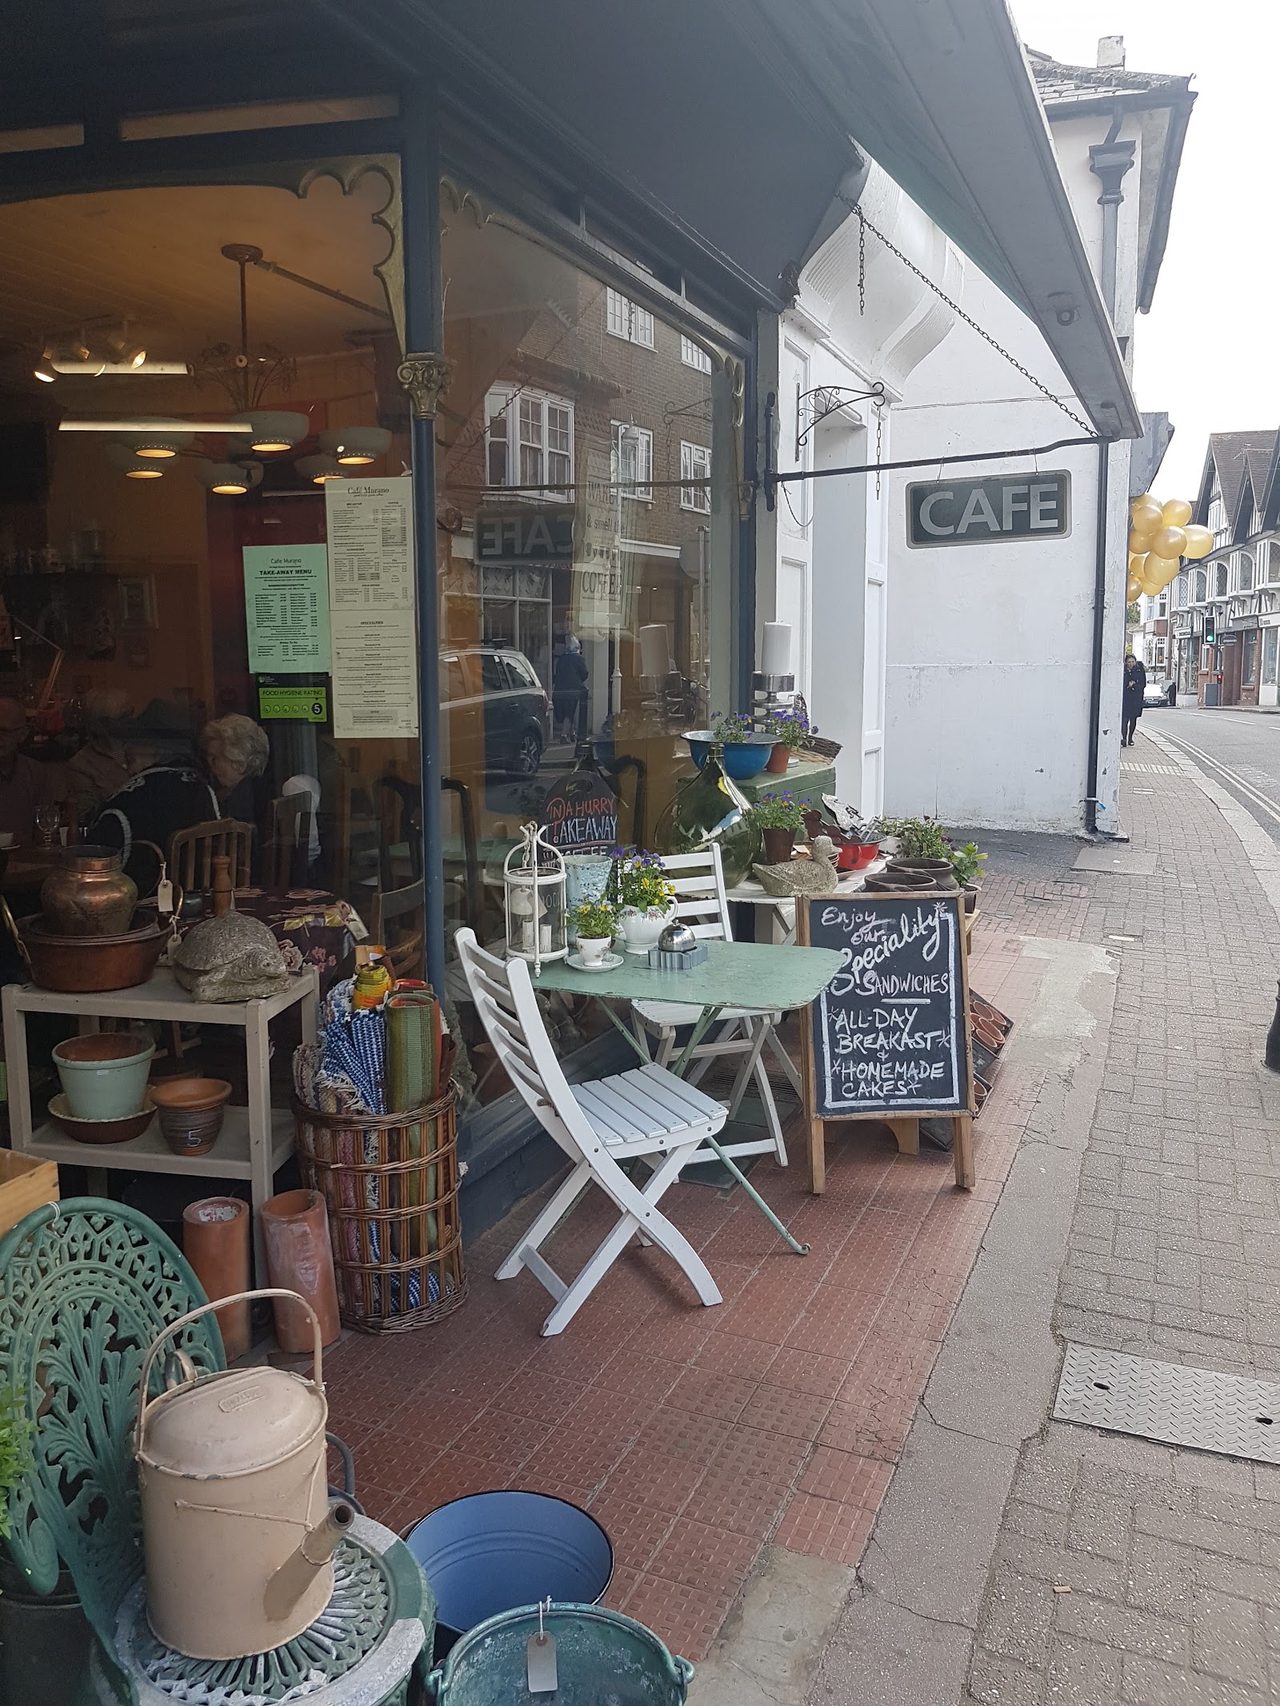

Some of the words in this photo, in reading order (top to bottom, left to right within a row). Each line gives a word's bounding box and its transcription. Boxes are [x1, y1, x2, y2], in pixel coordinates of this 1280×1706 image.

[919, 483, 1059, 536] CAFE
[313, 704, 321, 715] 5
[575, 799, 614, 816] HURRY
[821, 906, 896, 932] Enjoy
[835, 1007, 919, 1036] ALL-DAY
[841, 1061, 945, 1083] HOMEMADE
[842, 1081, 908, 1098] CAKES
[187, 1128, 203, 1147] 5
